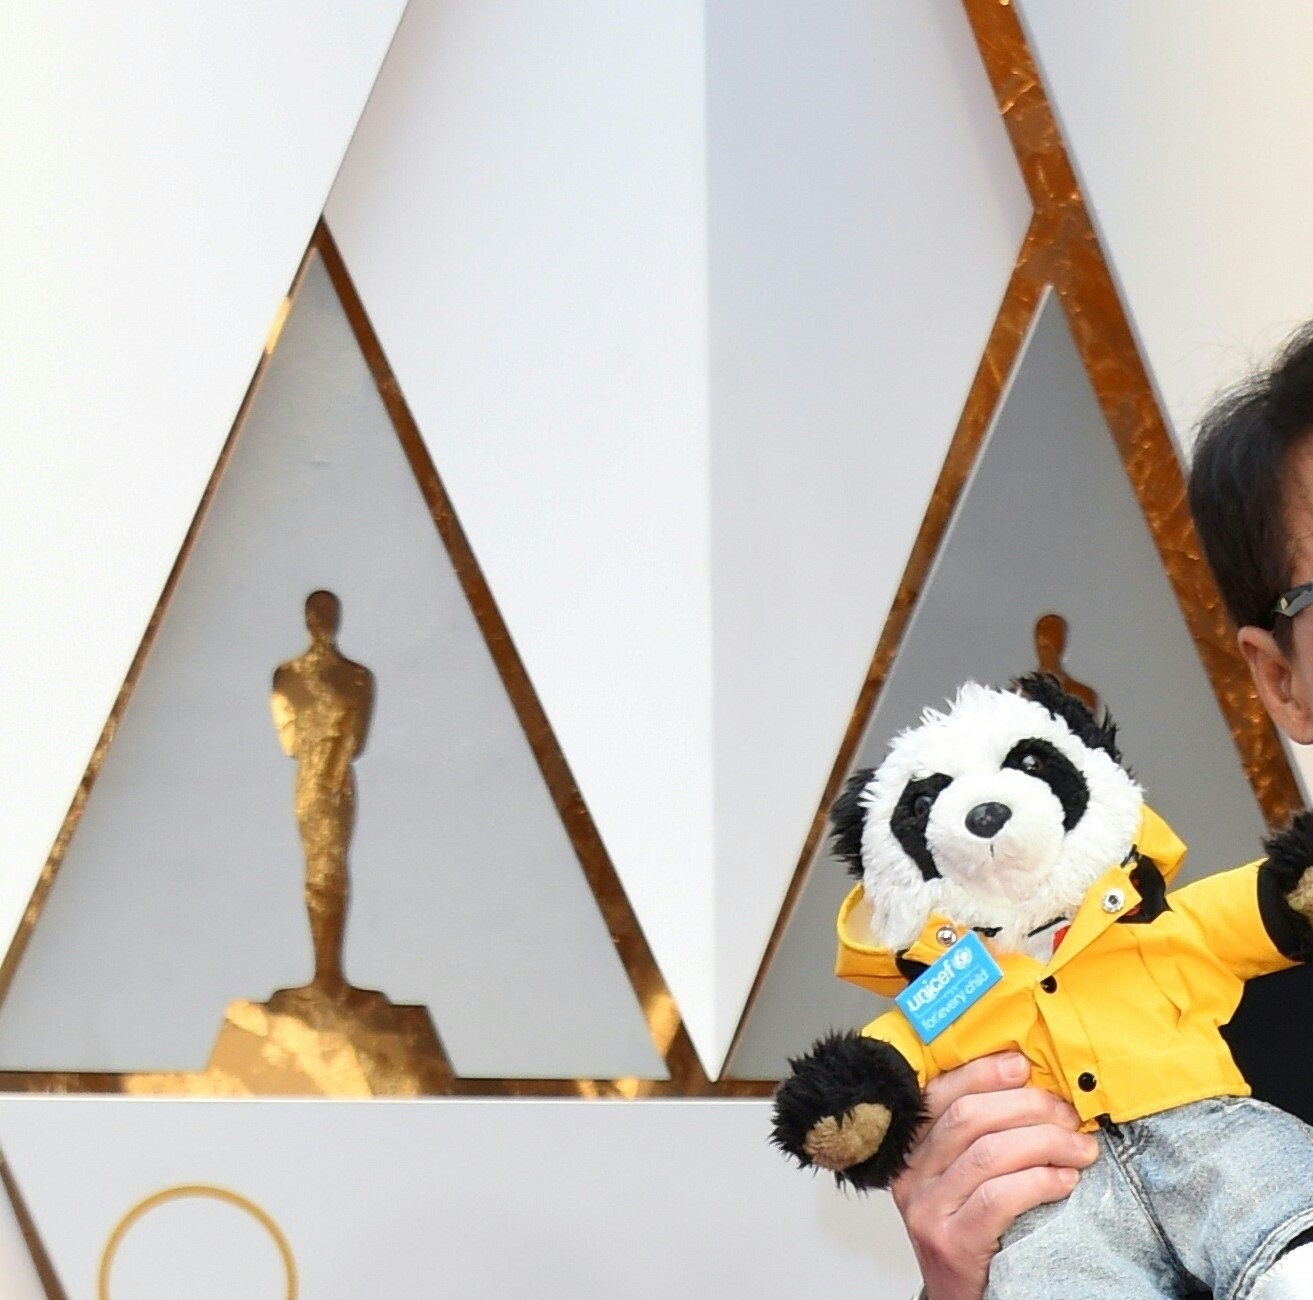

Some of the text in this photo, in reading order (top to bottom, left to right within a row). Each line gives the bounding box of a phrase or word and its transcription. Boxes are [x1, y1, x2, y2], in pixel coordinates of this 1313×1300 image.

[907, 959, 956, 1011] unicef
[922, 968, 990, 1031] for every child
